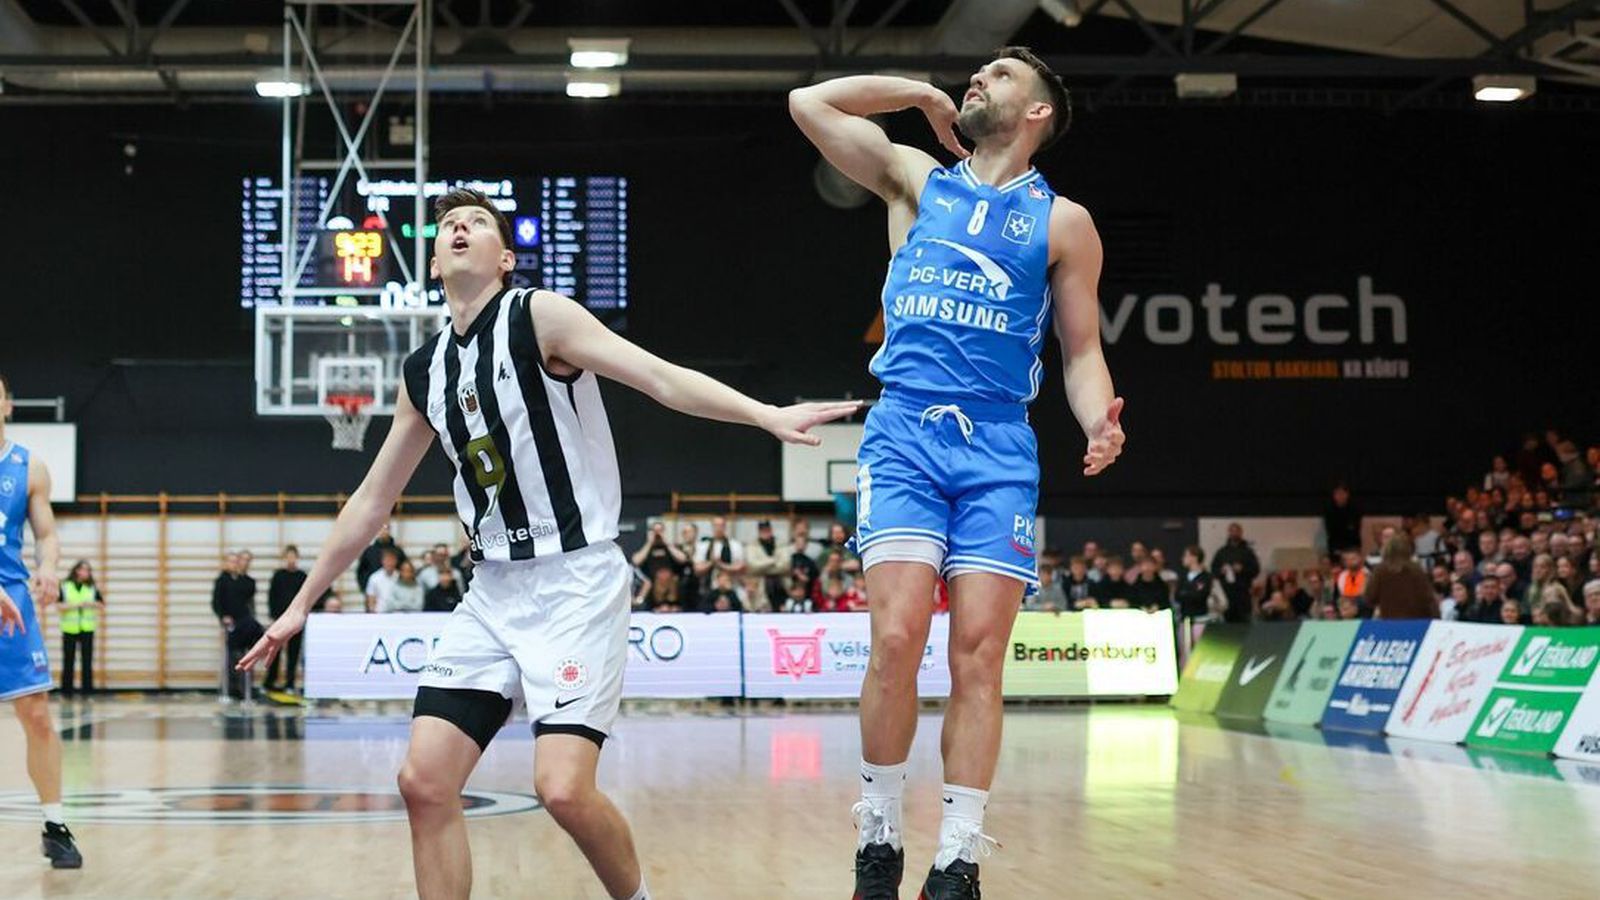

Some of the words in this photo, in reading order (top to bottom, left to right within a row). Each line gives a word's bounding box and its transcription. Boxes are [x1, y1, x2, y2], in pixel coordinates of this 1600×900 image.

[967, 200, 989, 235] 8
[894, 295, 1009, 333] SAMSUNG
[1099, 276, 1408, 344] votech
[470, 520, 553, 552] alvotech
[1014, 643, 1156, 664] Brandenburg
